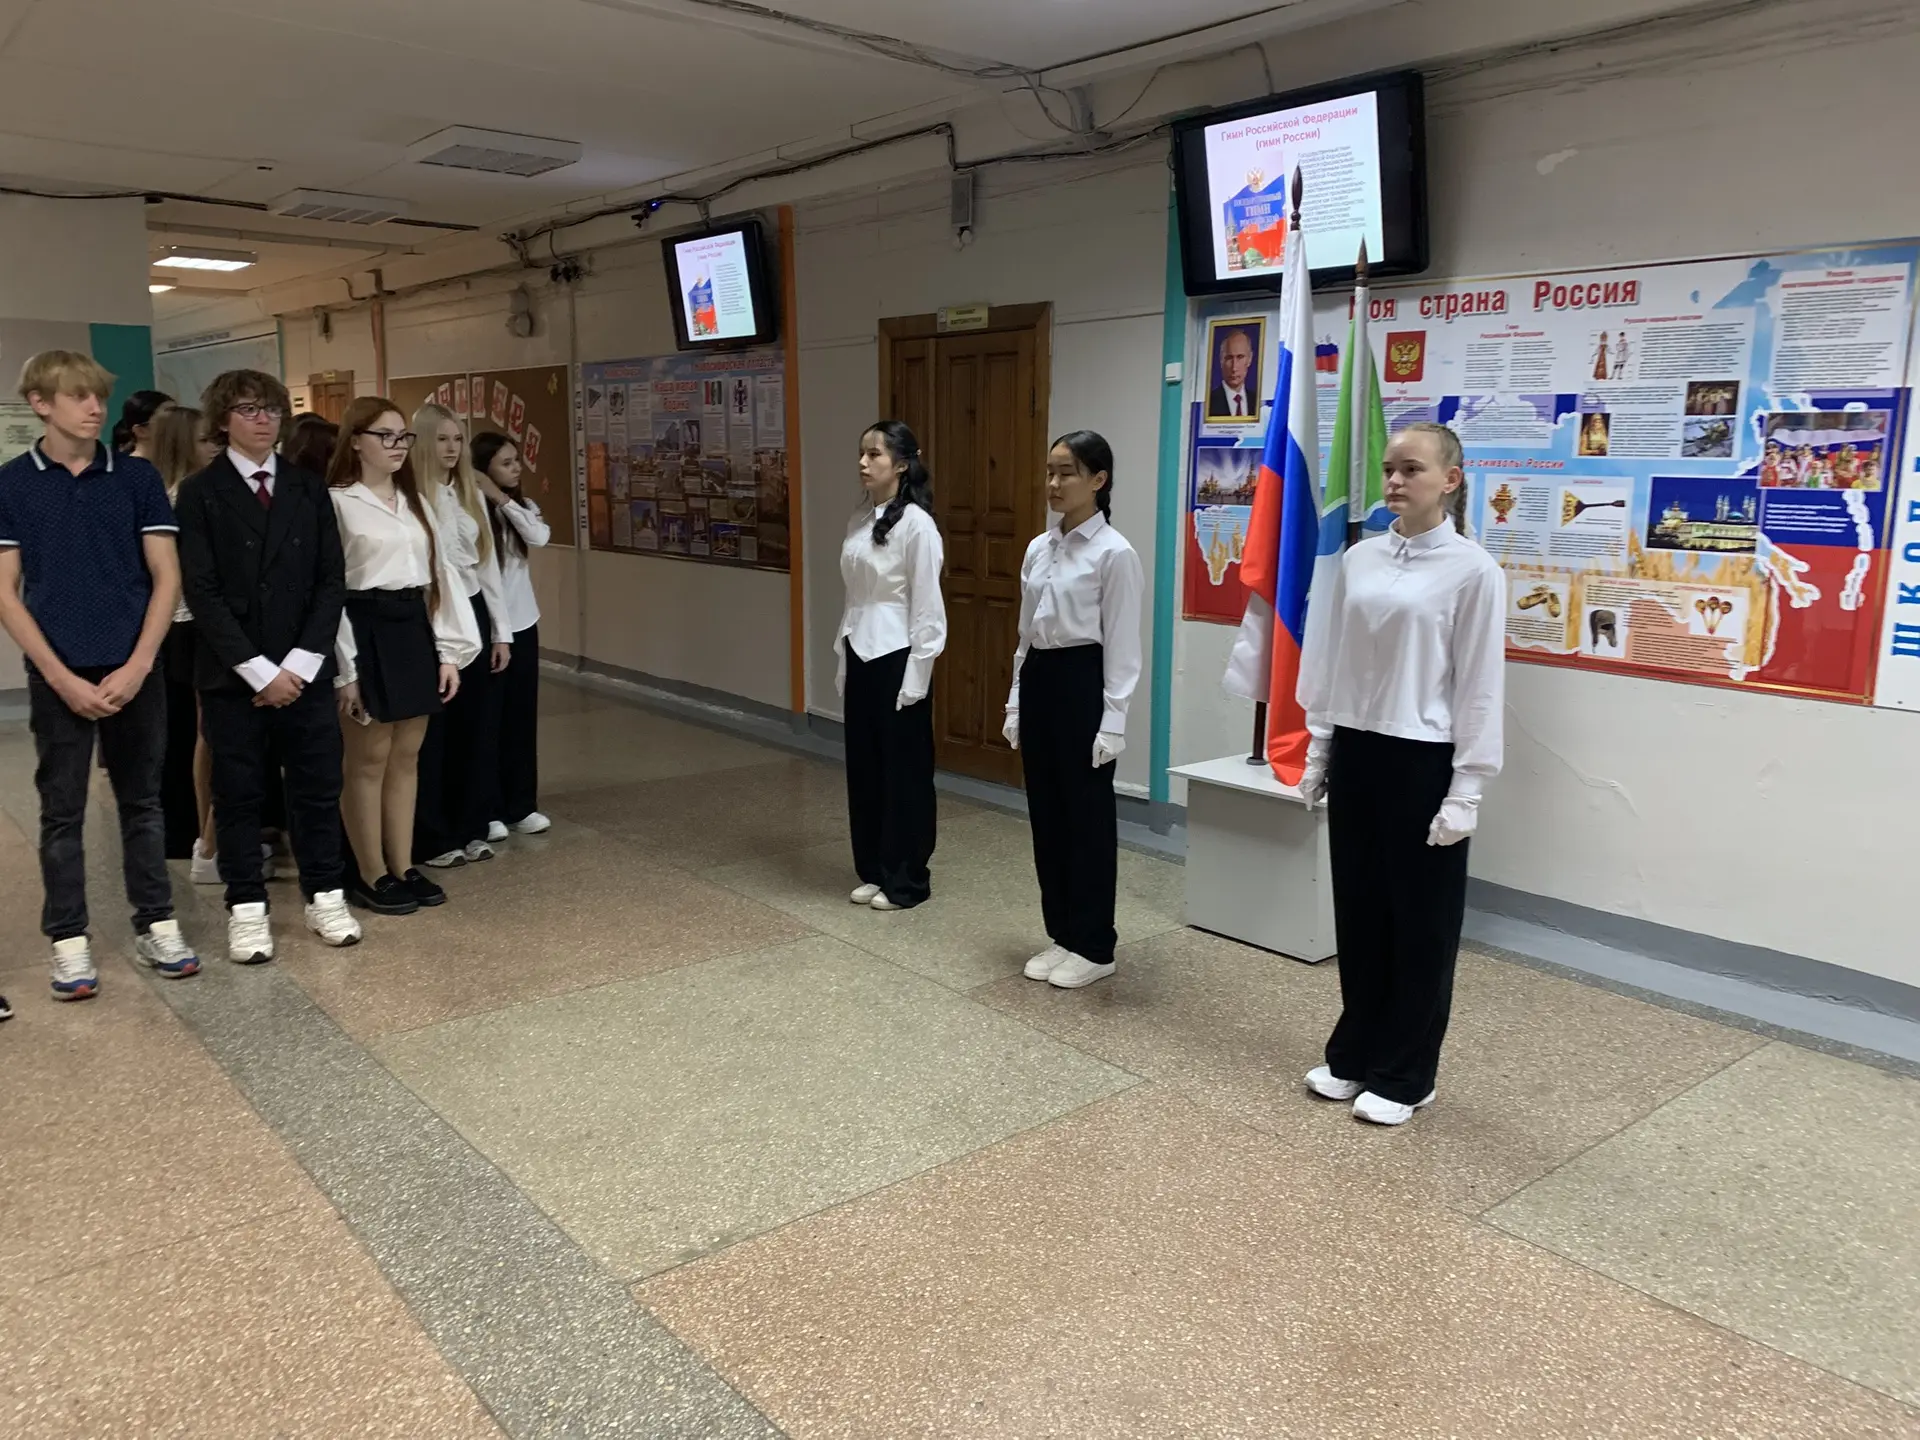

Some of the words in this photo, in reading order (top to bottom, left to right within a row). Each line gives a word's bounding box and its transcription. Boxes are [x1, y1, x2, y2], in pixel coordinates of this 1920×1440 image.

[1221, 131, 1244, 142] Гимн
[1245, 116, 1300, 137] Российской
[1303, 107, 1358, 126] Федерации
[1256, 137, 1281, 151] (гимн
[1283, 127, 1321, 144] России)
[1420, 290, 1505, 321] страна
[1534, 280, 1637, 309] Россия
[1478, 459, 1522, 468] символы
[1525, 458, 1564, 469] России
